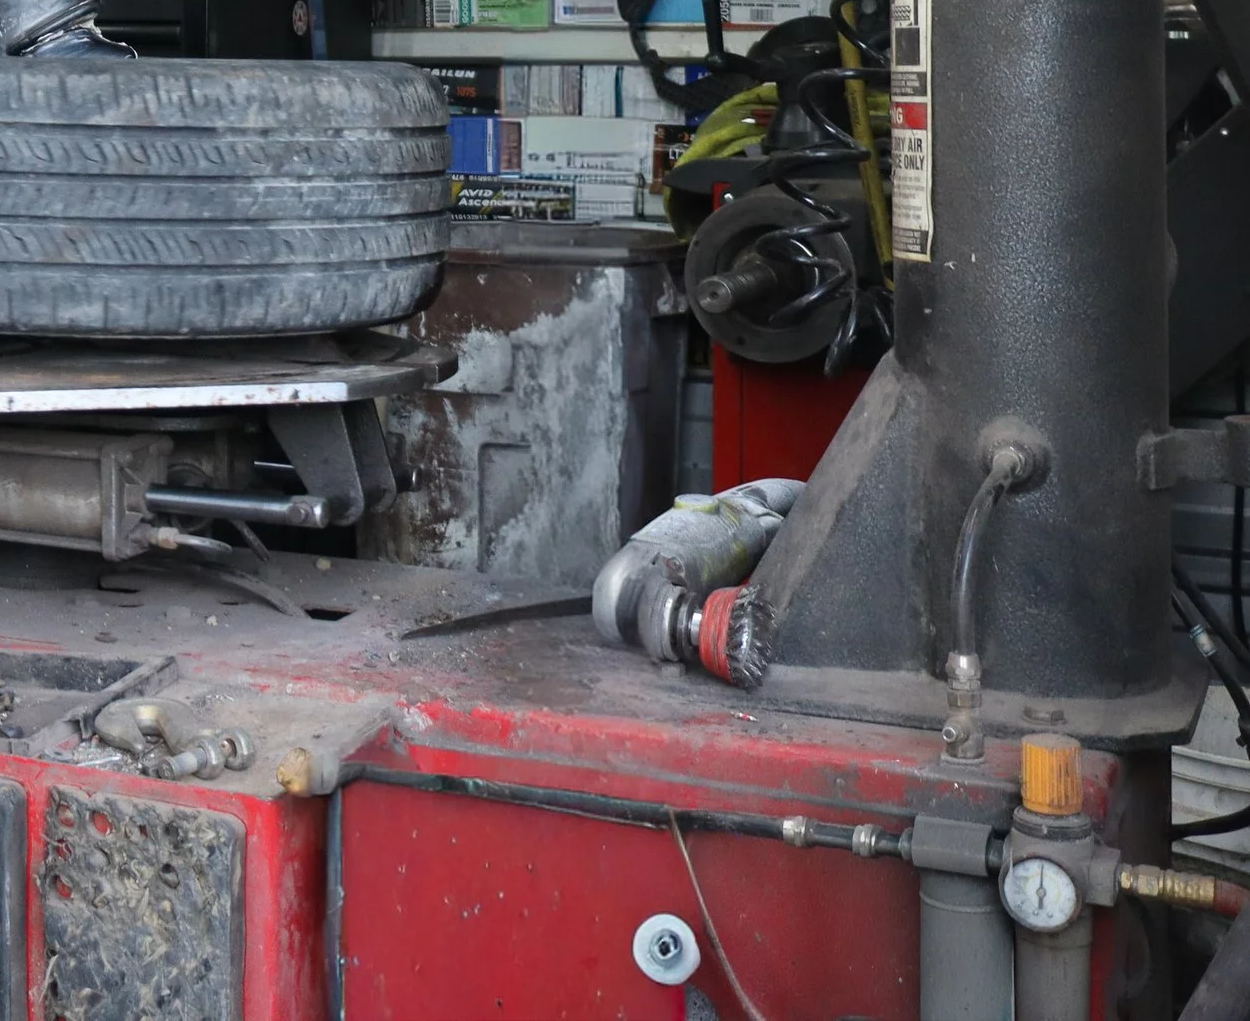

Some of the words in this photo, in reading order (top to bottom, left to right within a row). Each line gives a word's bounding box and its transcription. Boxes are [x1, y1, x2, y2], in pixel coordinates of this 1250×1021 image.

[908, 138, 923, 153] AIR
[904, 154, 925, 171] ONLY
[458, 189, 493, 197] AVID
